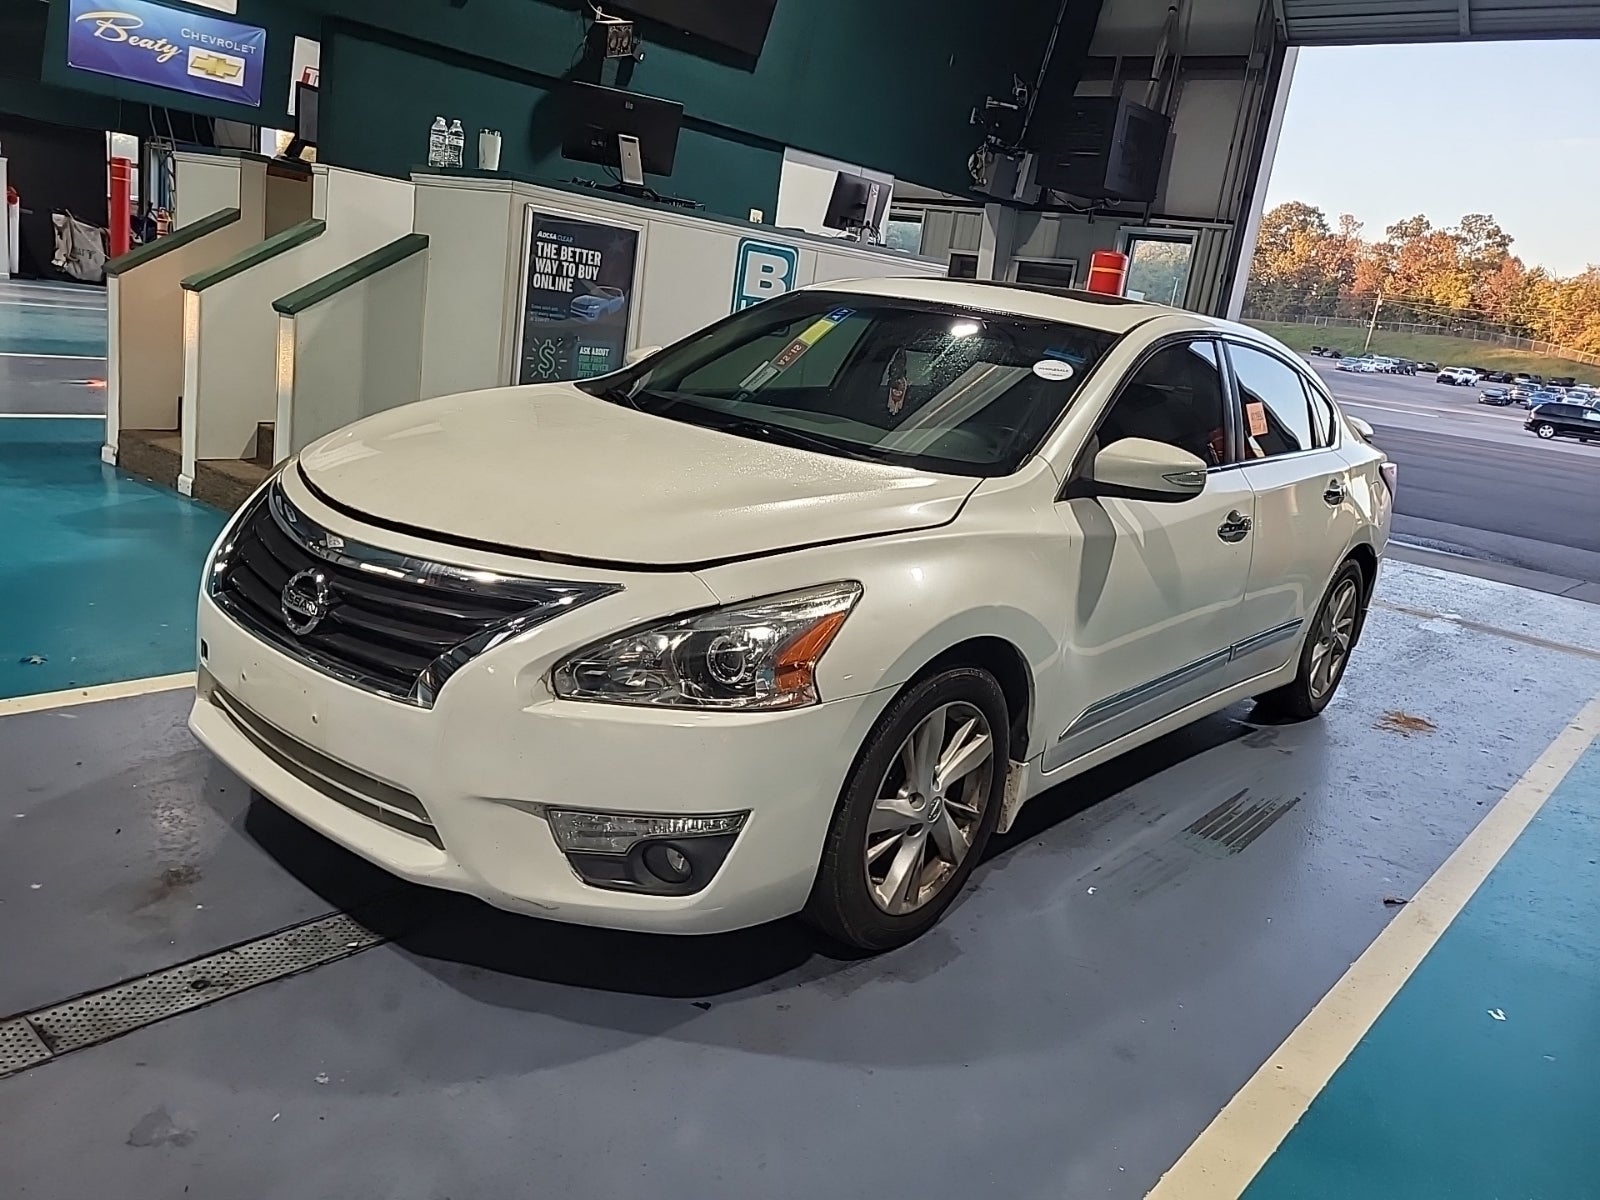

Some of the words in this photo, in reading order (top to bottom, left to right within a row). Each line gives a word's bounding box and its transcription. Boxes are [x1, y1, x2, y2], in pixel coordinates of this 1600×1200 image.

[75, 11, 183, 63] Beaty
[181, 28, 256, 55] CHEVROLET
[536, 241, 558, 259] THE
[560, 246, 602, 266] BETTER
[535, 257, 559, 275] WAY
[562, 261, 576, 277] TO
[578, 264, 600, 281] BUY
[533, 273, 574, 293] ONLINE
[579, 346, 591, 356] ASK
[591, 348, 610, 357] ABOUT
